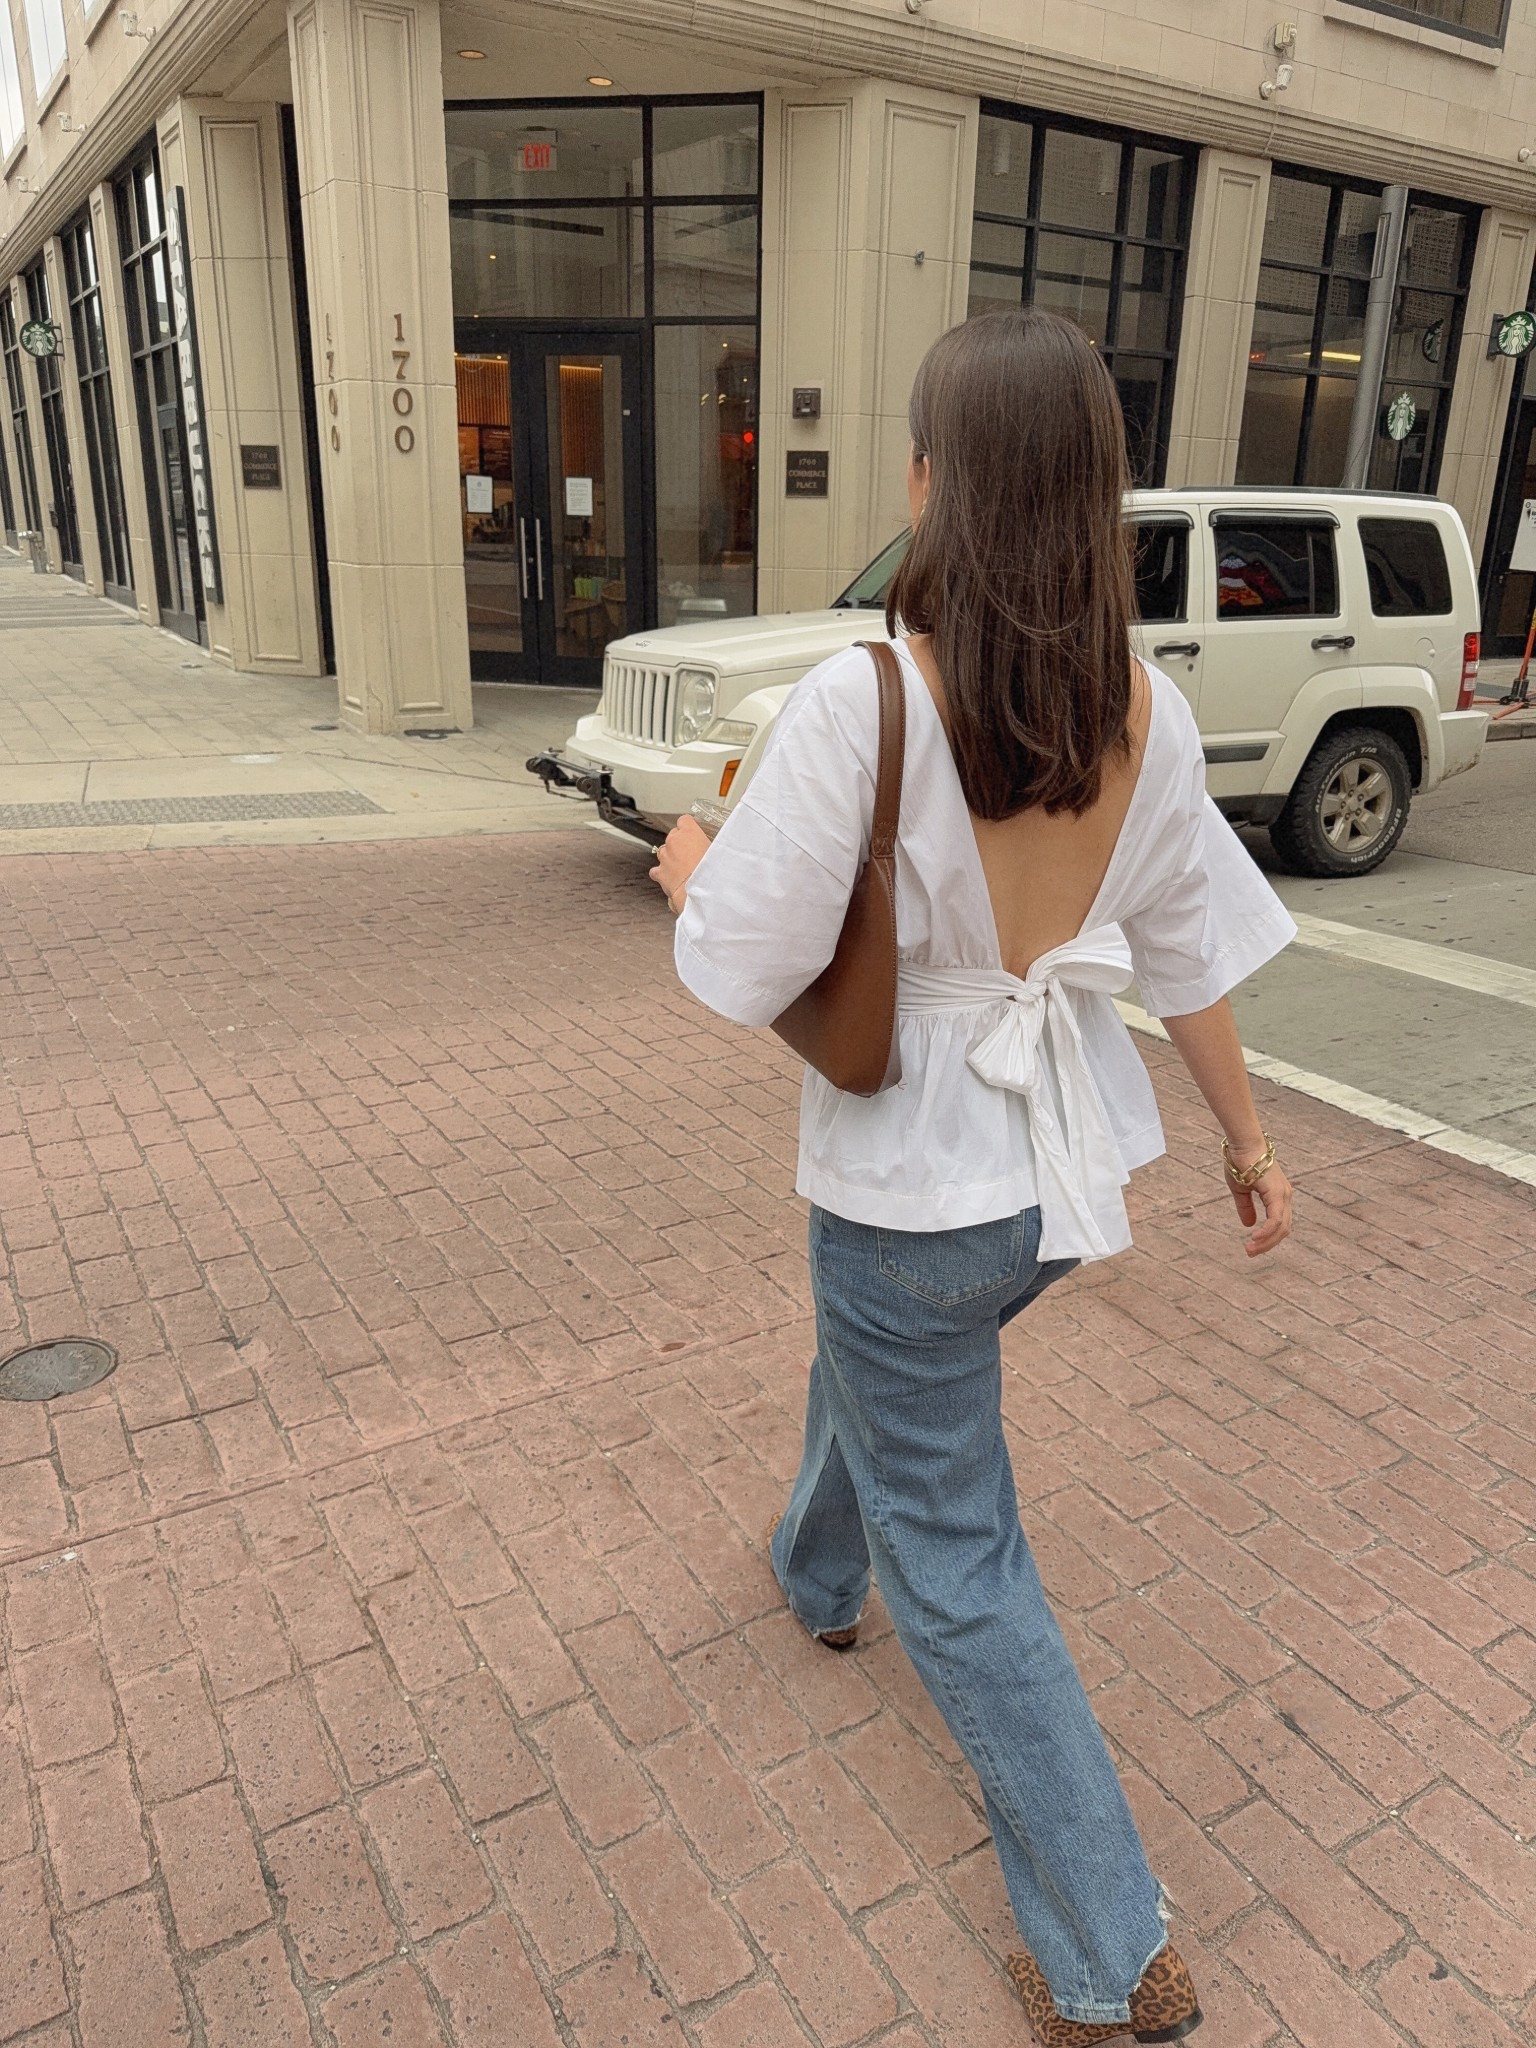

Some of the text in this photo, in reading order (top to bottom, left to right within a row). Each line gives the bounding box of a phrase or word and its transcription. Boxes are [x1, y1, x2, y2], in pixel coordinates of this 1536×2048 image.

[523, 143, 552, 169] EXIT
[168, 206, 216, 589] STARBUCKS
[325, 312, 340, 453] 1700
[391, 312, 415, 454] 1700
[795, 481, 818, 489] PLACE
[1350, 808, 1403, 864] BFGoodrich
